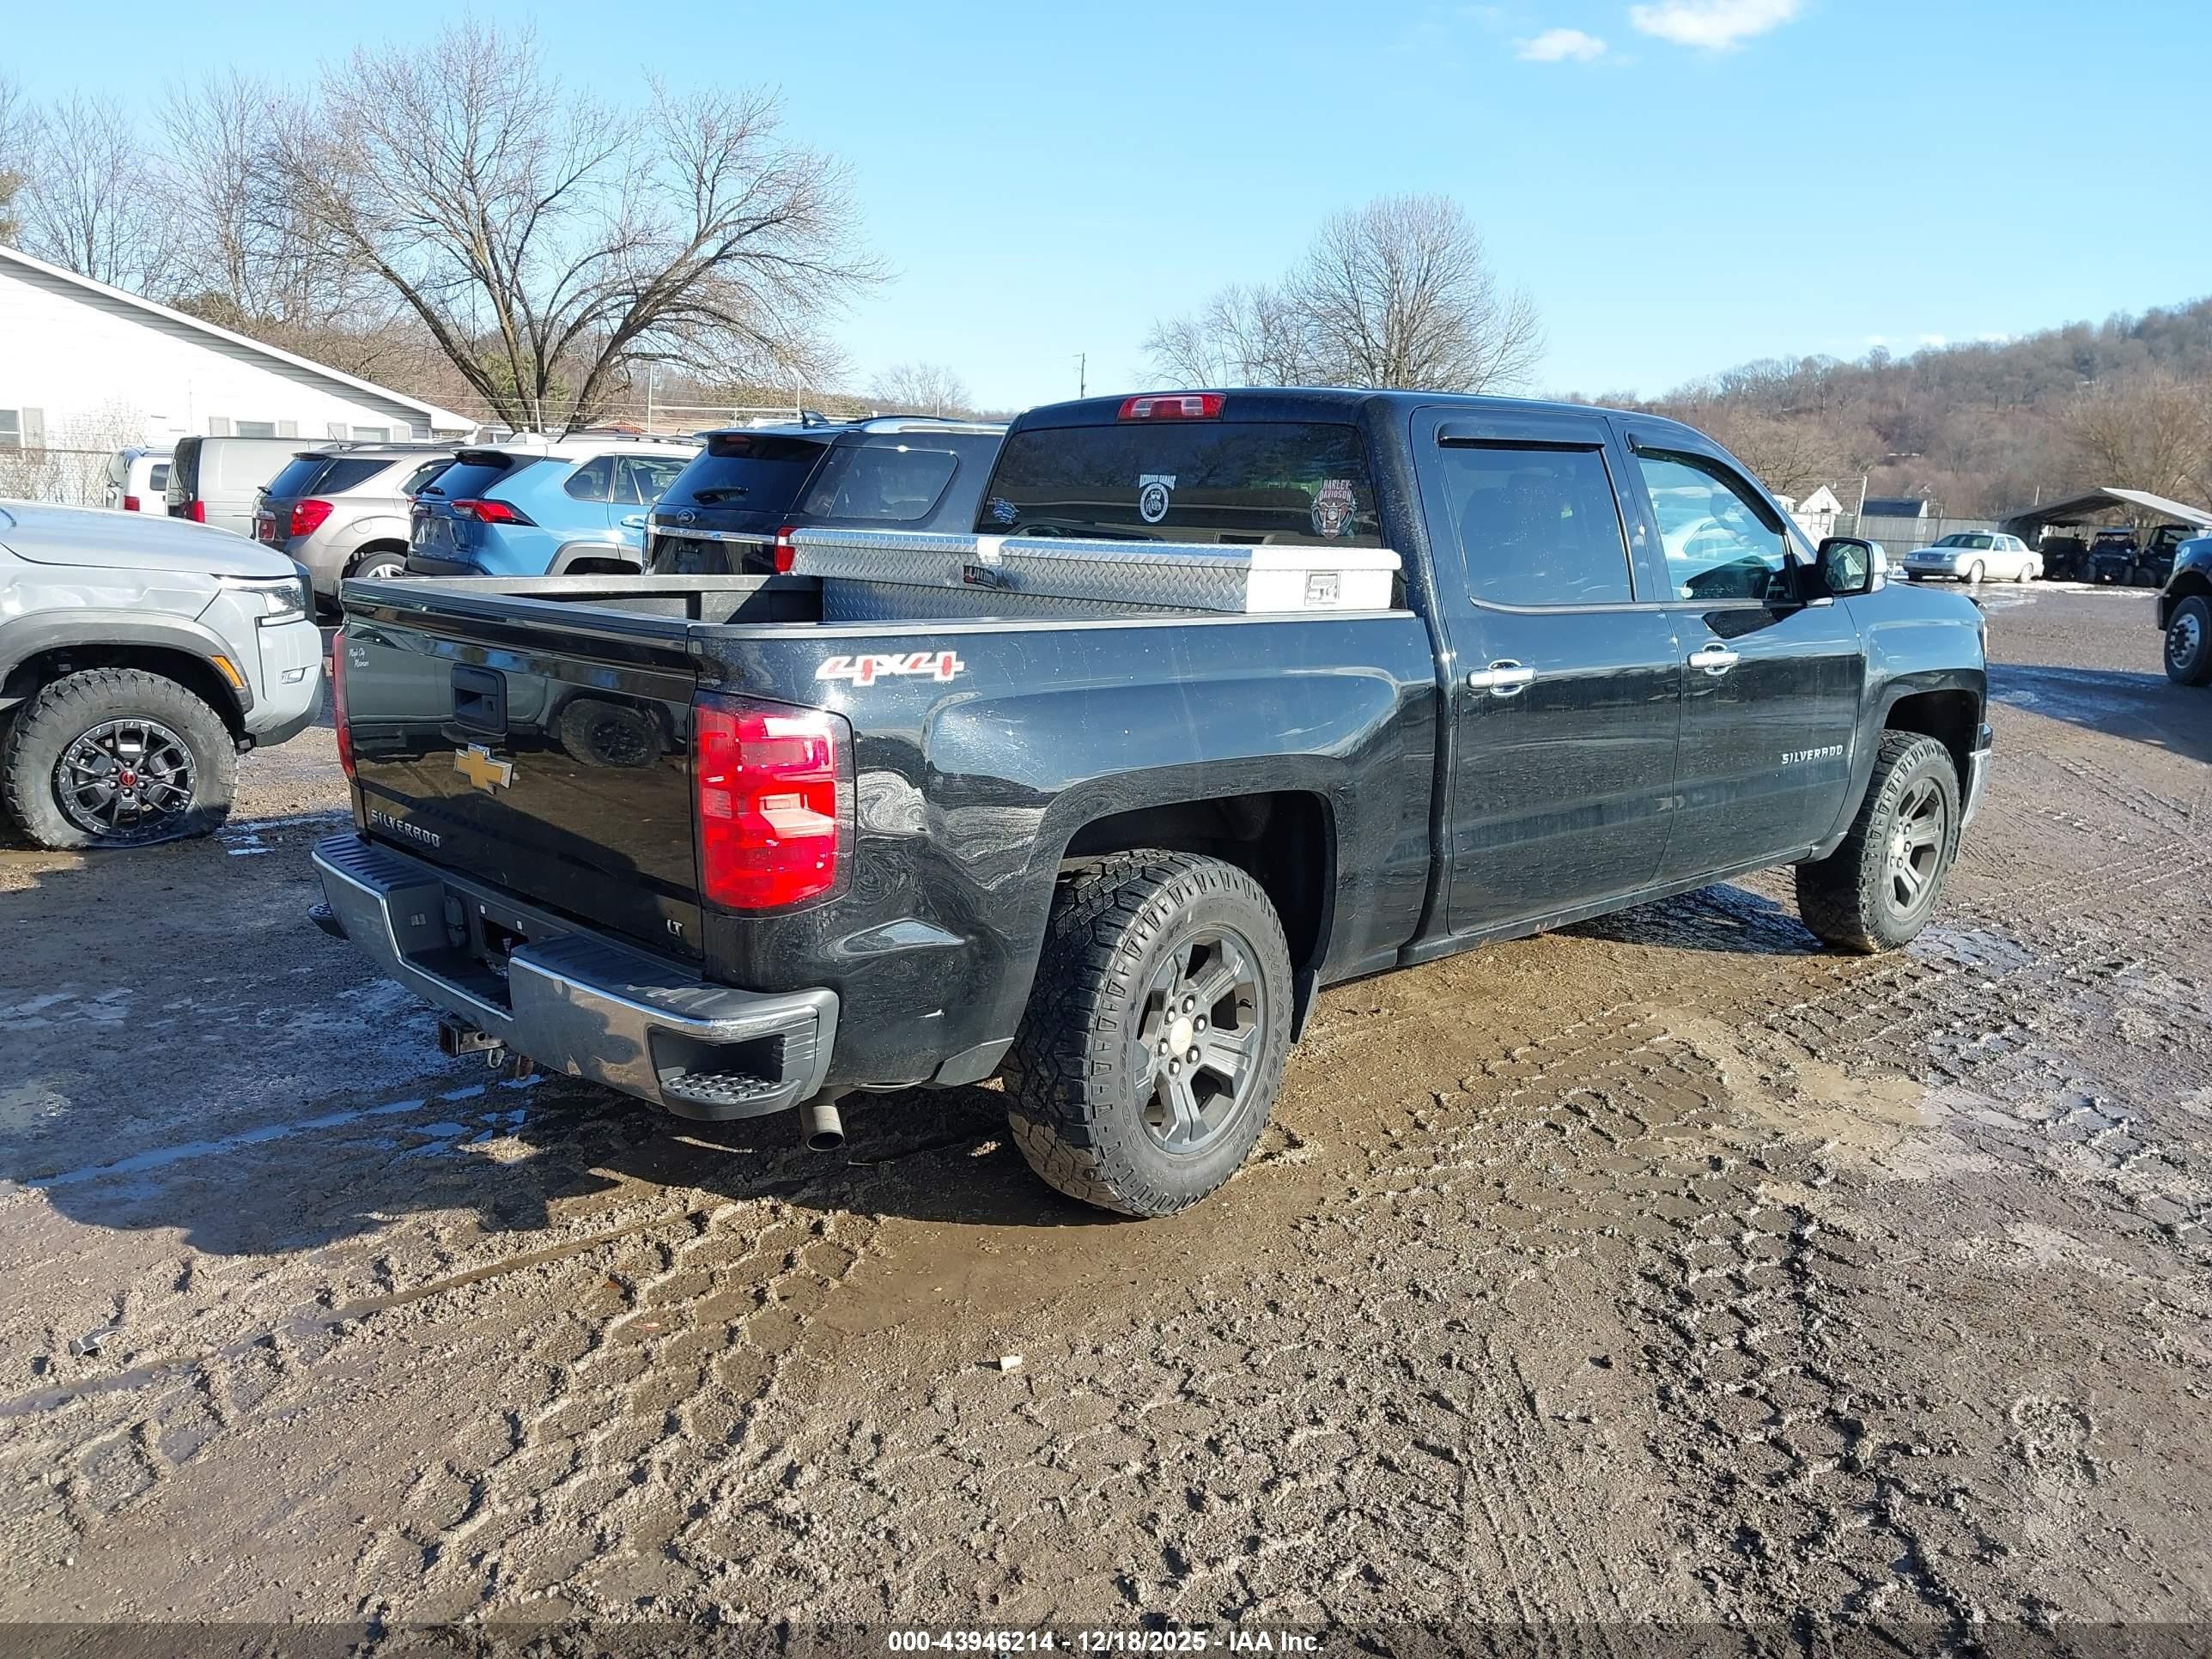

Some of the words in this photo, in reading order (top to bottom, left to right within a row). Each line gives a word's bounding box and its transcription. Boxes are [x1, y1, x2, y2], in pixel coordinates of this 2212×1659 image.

[1319, 489, 1352, 502] DAVIDSON
[1781, 744, 1844, 764] SILVERADO
[371, 809, 441, 848] SILVERADO
[666, 919, 684, 937] LT
